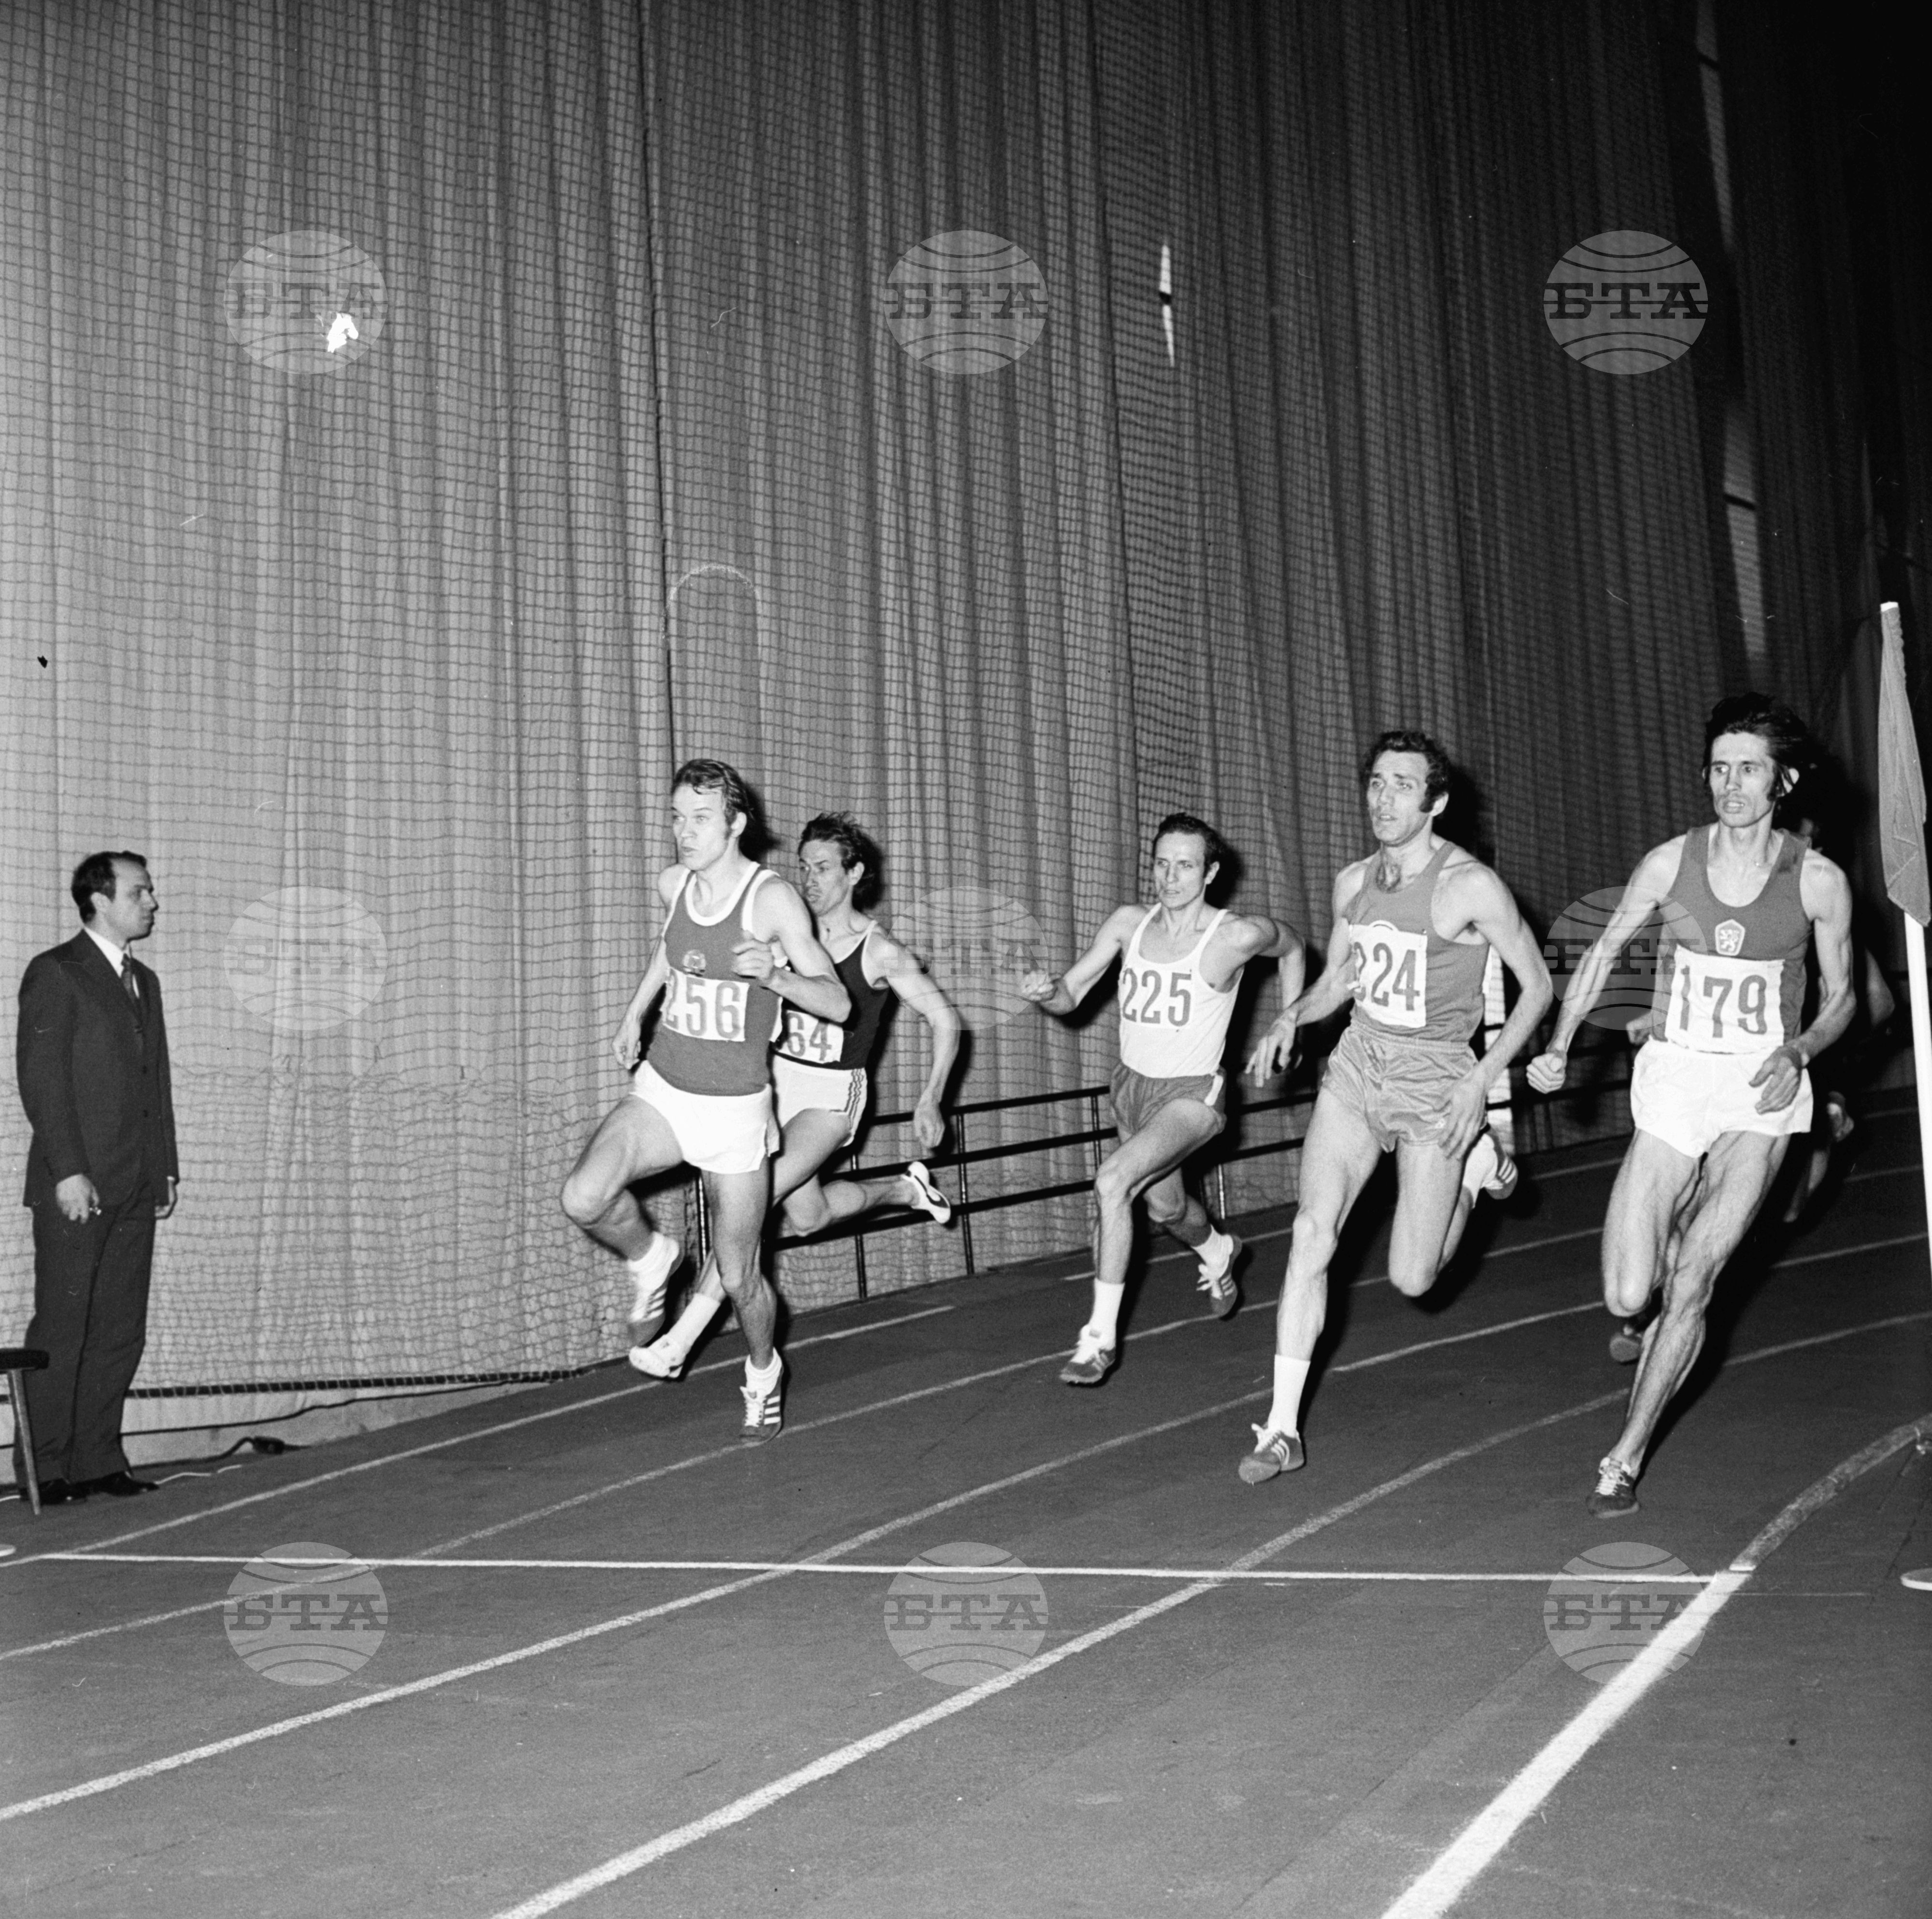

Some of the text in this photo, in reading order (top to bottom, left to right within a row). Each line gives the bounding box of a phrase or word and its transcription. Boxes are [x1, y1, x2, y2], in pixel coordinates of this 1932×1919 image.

[665, 968, 740, 1039] 256
[1122, 968, 1192, 1027] 225
[1352, 941, 1421, 1011] 224
[1679, 964, 1768, 1038] 179
